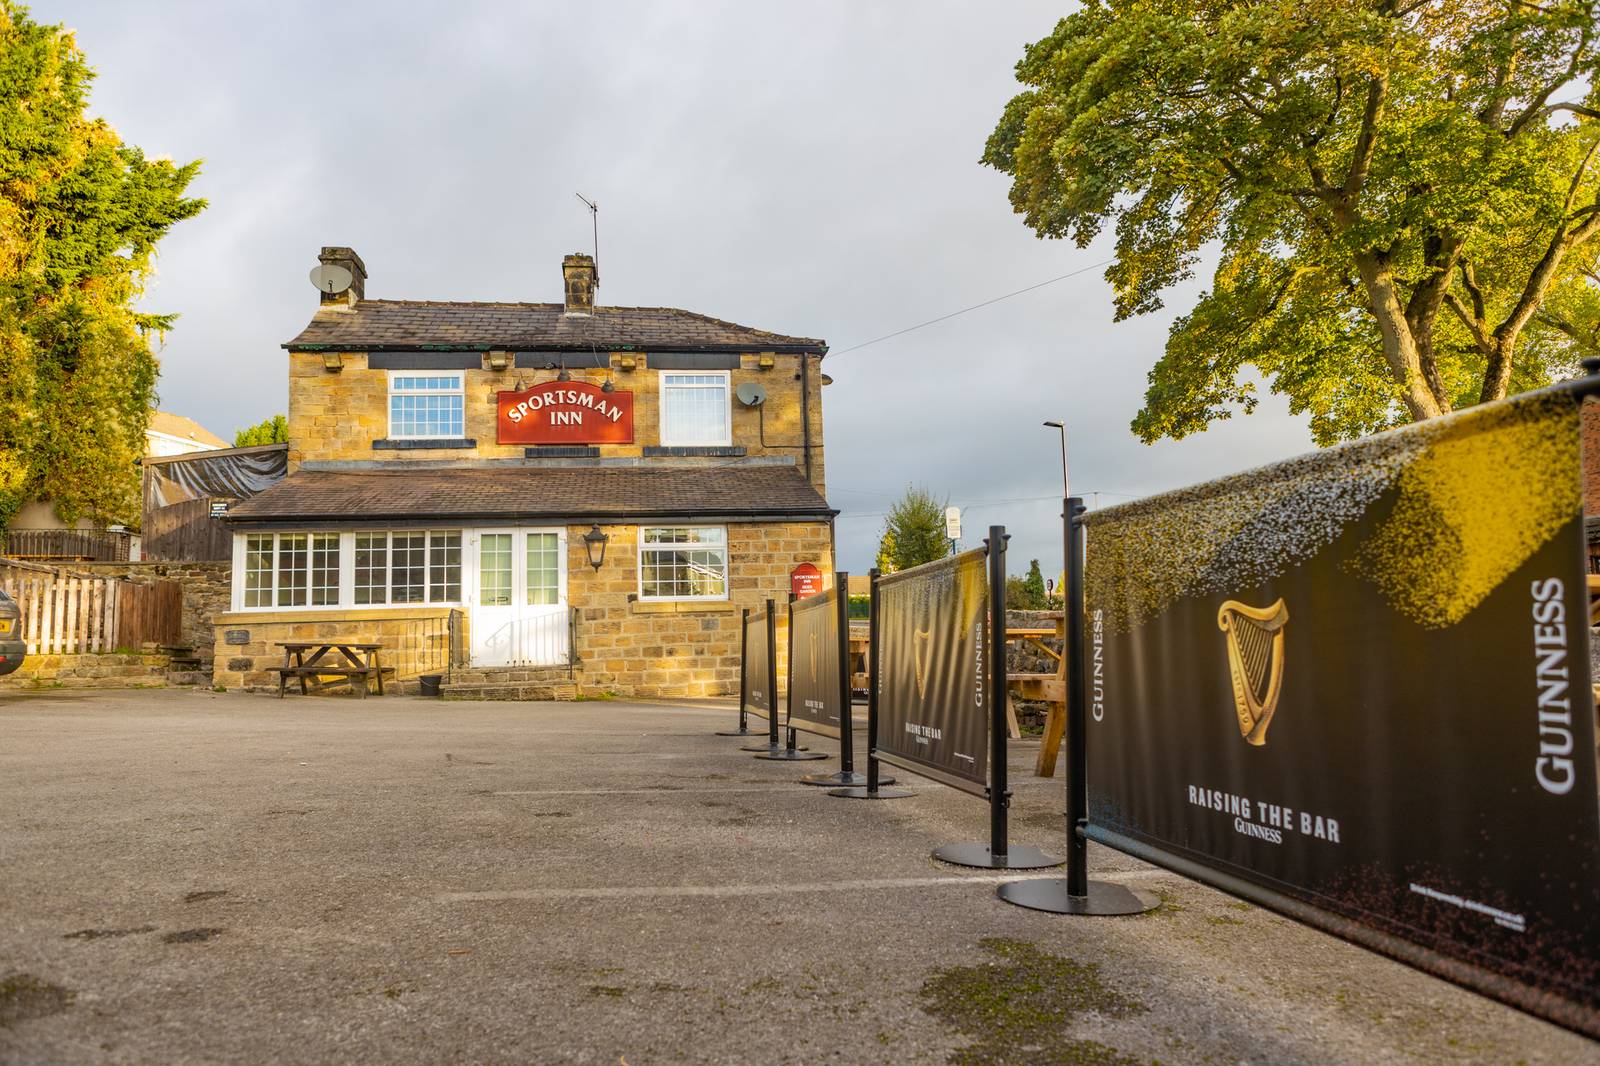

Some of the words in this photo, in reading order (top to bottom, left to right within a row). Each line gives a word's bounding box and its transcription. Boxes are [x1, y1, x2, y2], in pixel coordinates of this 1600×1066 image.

[508, 390, 623, 423] SPORTSMAN
[550, 411, 582, 425] INN
[975, 622, 983, 708] GUINNESS
[1092, 609, 1104, 722] GUINNESS
[1530, 577, 1575, 795] GUINNESS
[1188, 784, 1251, 819] RAISING
[1257, 801, 1293, 830] THE
[1300, 811, 1340, 843] BAR
[1234, 816, 1283, 844] GUINNESS
